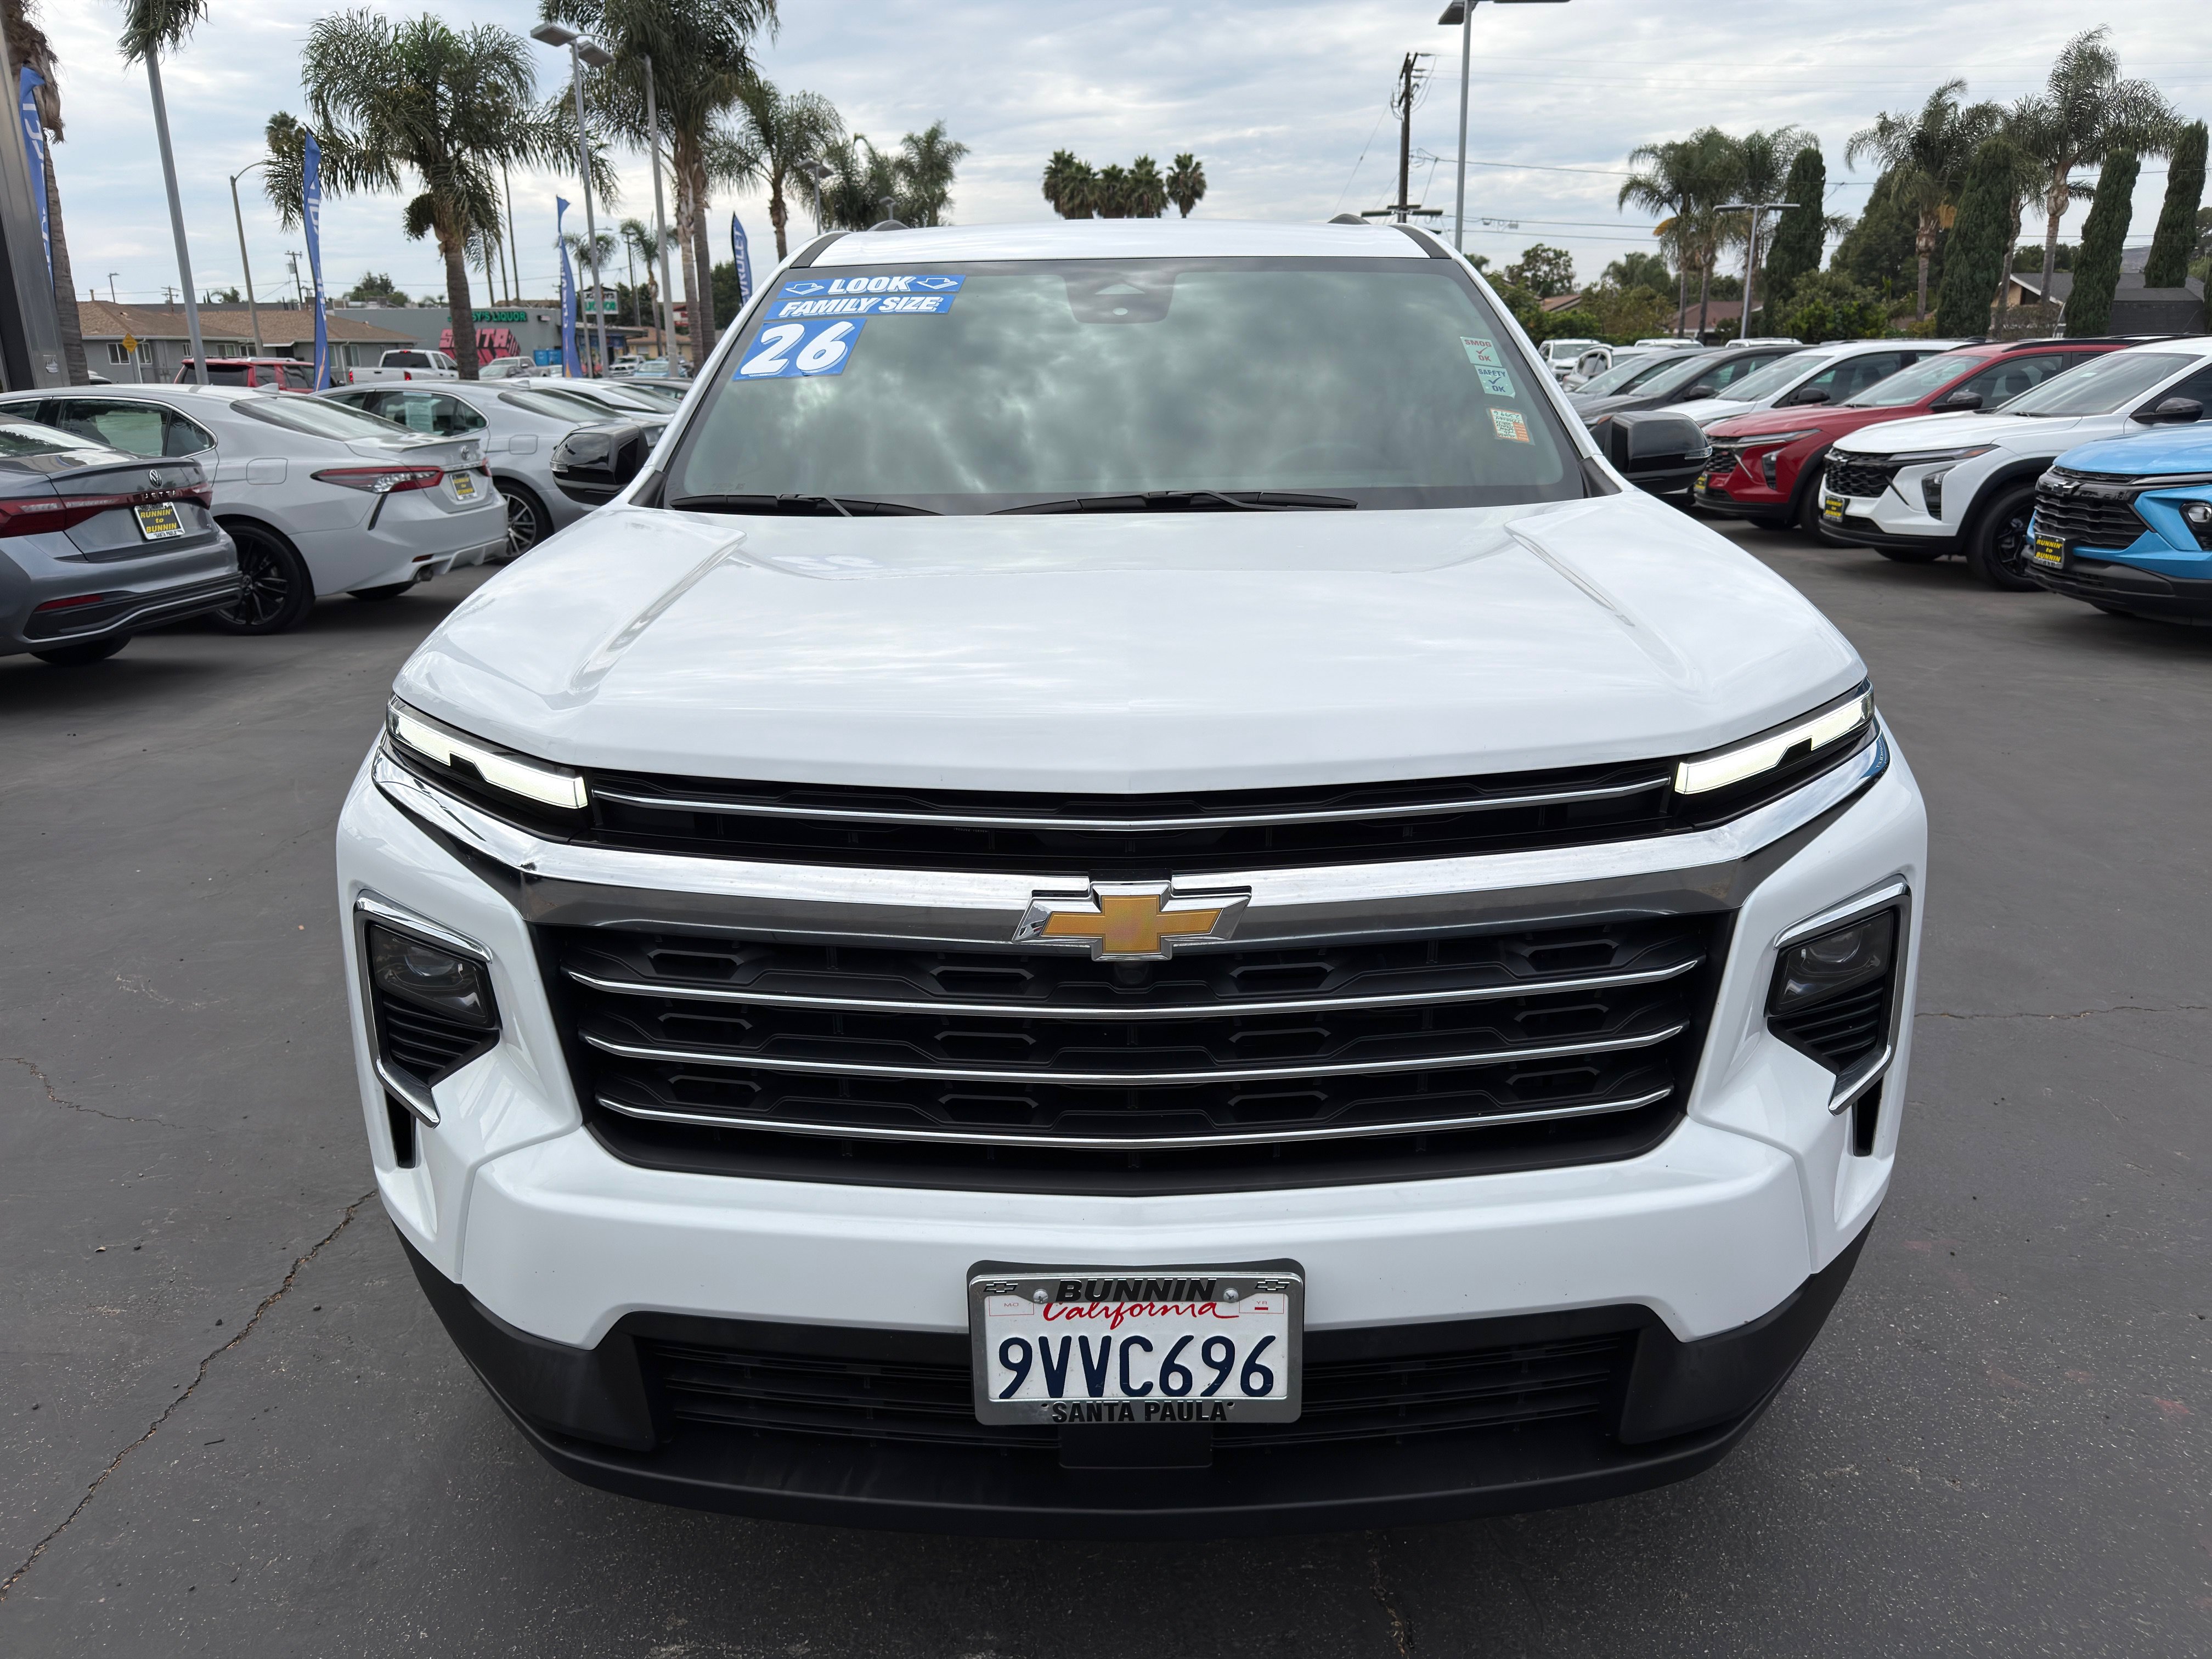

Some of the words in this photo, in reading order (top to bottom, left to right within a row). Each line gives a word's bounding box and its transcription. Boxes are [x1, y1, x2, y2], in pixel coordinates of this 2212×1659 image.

[828, 276, 917, 295] LOOK
[493, 311, 526, 322] LIQUOR
[778, 297, 881, 318] FAMILY
[878, 296, 944, 313] SIZE
[439, 329, 510, 348] STA
[740, 321, 855, 377] 26
[1478, 369, 1506, 377] SAFETY
[140, 509, 173, 518] RUNNIN'
[146, 522, 177, 533] BUNNIN
[1056, 1279, 1217, 1303] BUNNIN
[1042, 1301, 1239, 1330] California
[998, 1335, 1277, 1399] 9VVC696
[1052, 1401, 1135, 1424] SANTA
[1144, 1400, 1227, 1422] PAULA
